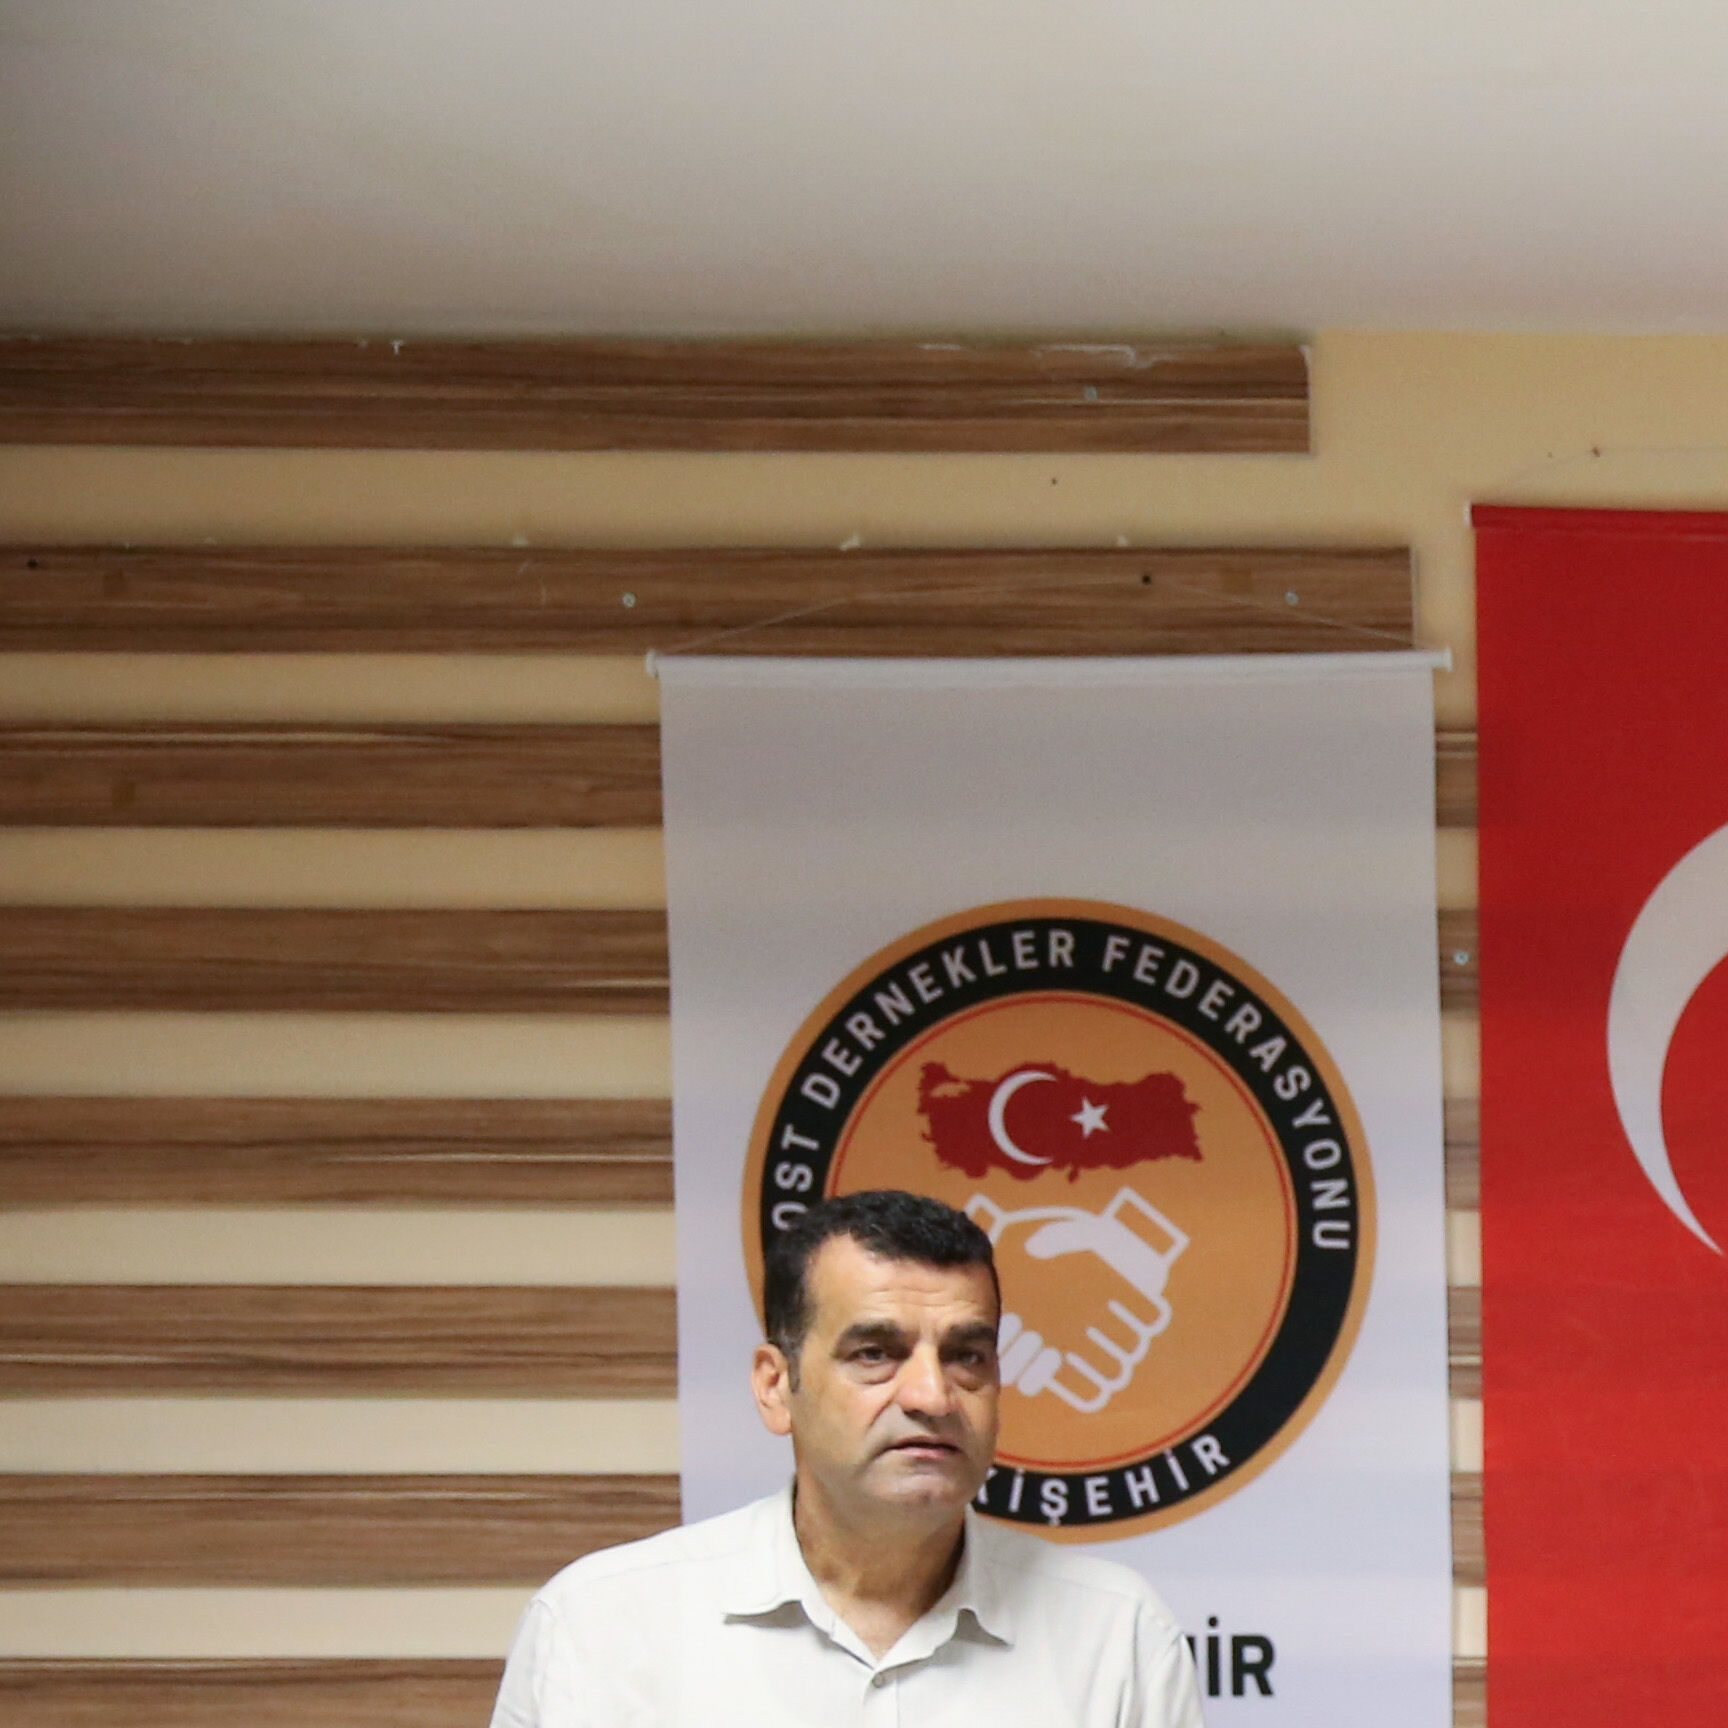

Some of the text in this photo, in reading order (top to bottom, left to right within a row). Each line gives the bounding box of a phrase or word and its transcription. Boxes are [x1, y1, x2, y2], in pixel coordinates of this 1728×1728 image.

[770, 928, 1352, 1253] OST DERNEKLER FEDERASYONU
[976, 1433, 1231, 1527] İŞEHİR
